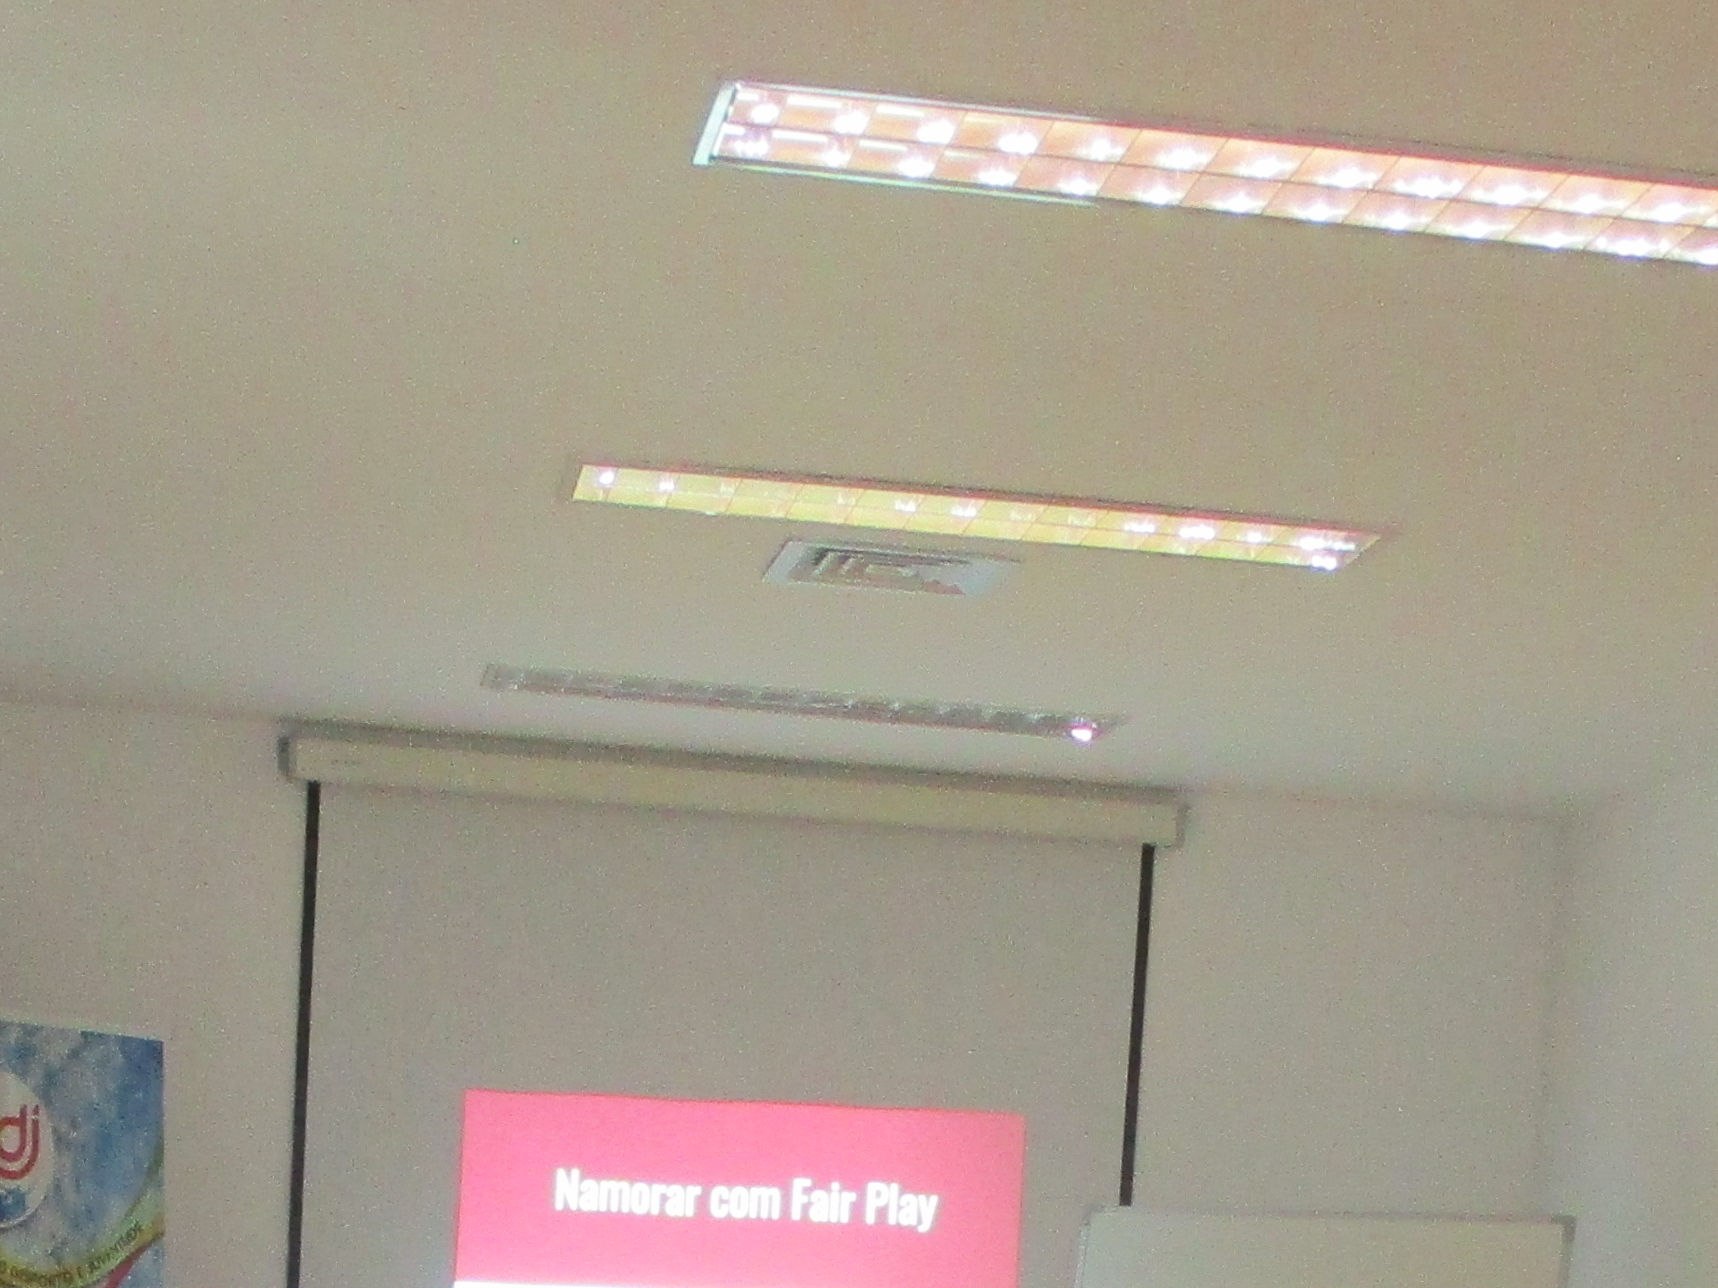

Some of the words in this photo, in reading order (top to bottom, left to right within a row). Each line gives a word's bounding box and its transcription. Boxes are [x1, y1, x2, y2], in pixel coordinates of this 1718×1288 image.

[554, 1167, 702, 1217] Namorar
[709, 1184, 781, 1221] com
[790, 1177, 857, 1225] Fair
[864, 1182, 939, 1233] Play
